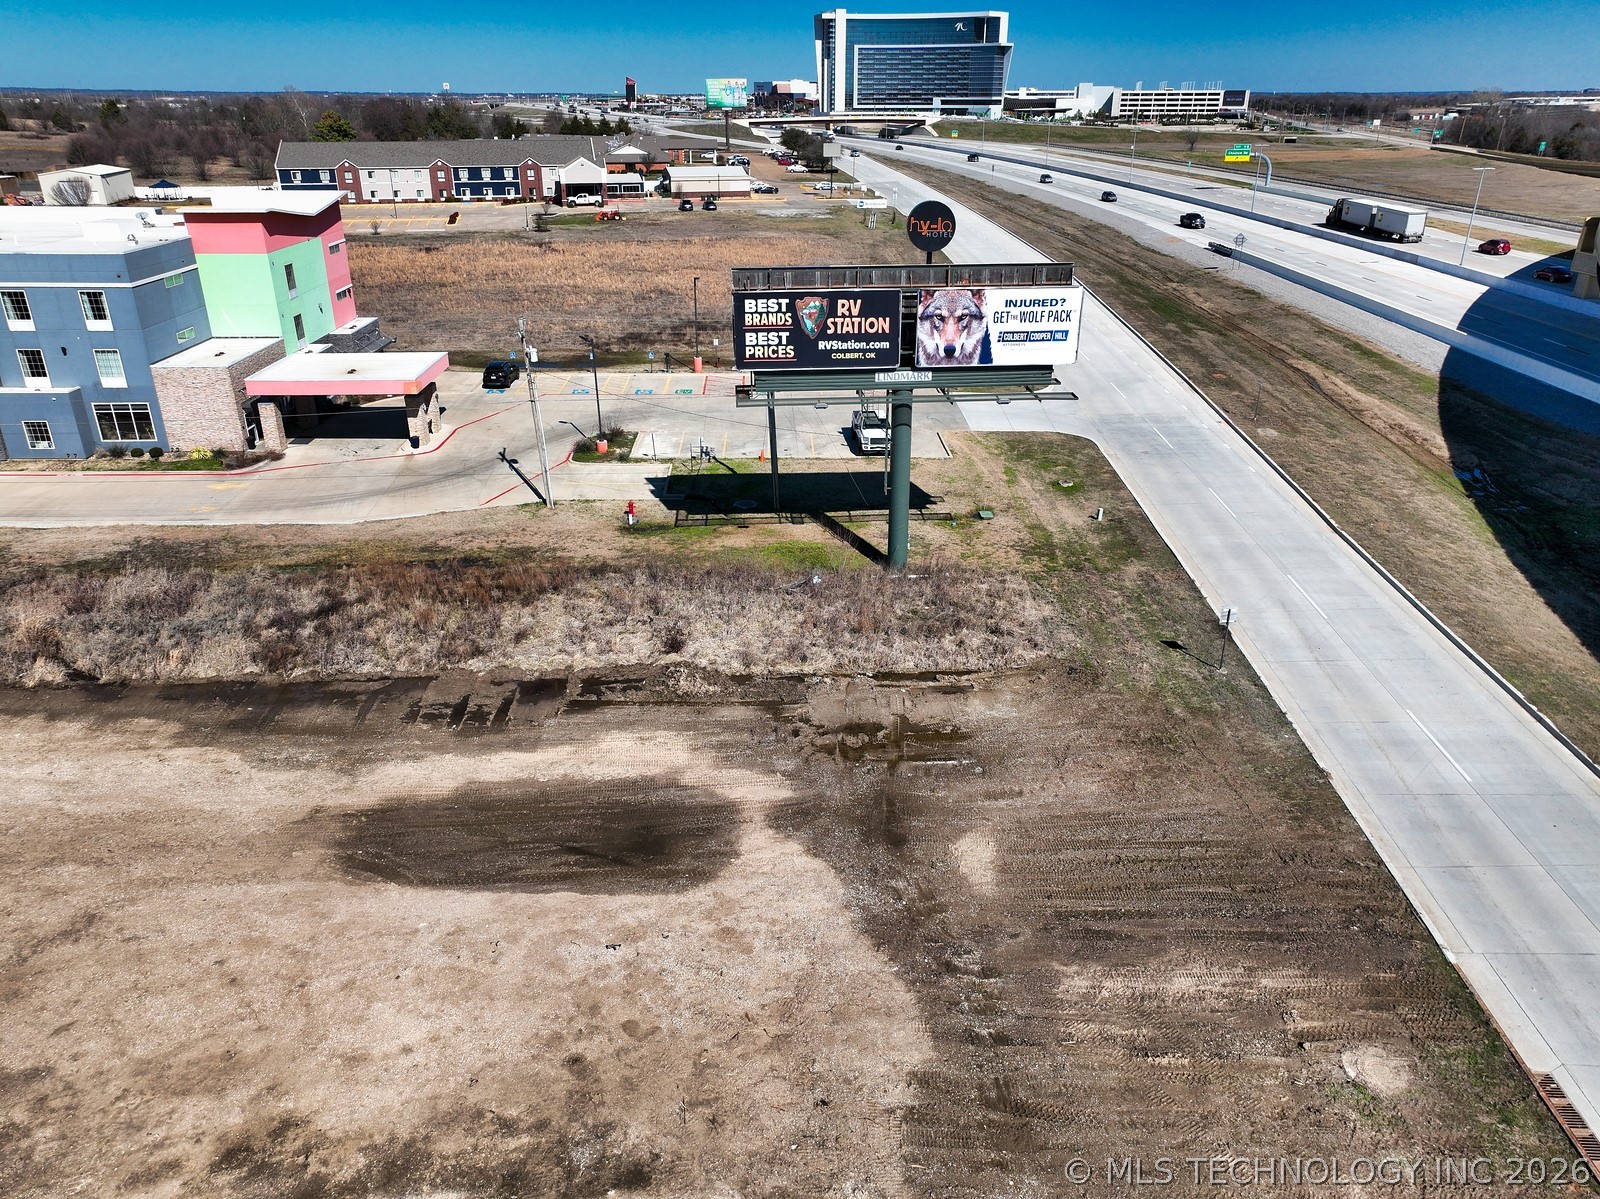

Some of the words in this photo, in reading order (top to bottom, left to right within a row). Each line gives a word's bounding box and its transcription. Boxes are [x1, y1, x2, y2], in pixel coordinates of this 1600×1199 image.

[910, 217, 953, 236] hy-lo
[744, 299, 789, 313] BEST
[837, 299, 862, 316] RV
[1004, 298, 1067, 308] INJURED?
[745, 313, 792, 326] BRANDS
[993, 311, 1011, 324] GET
[1019, 310, 1046, 323] WOLF
[1047, 309, 1073, 322] PACK
[826, 317, 890, 334] STATION
[745, 332, 790, 346] BEST
[1003, 332, 1028, 341] COLBERT
[1030, 332, 1052, 340] COOPER
[1054, 331, 1067, 340] HILL
[818, 340, 890, 350] RVStation.com
[745, 346, 795, 359] PRICES
[831, 352, 865, 360] COLBERT,
[877, 372, 931, 381] LINDMARK
